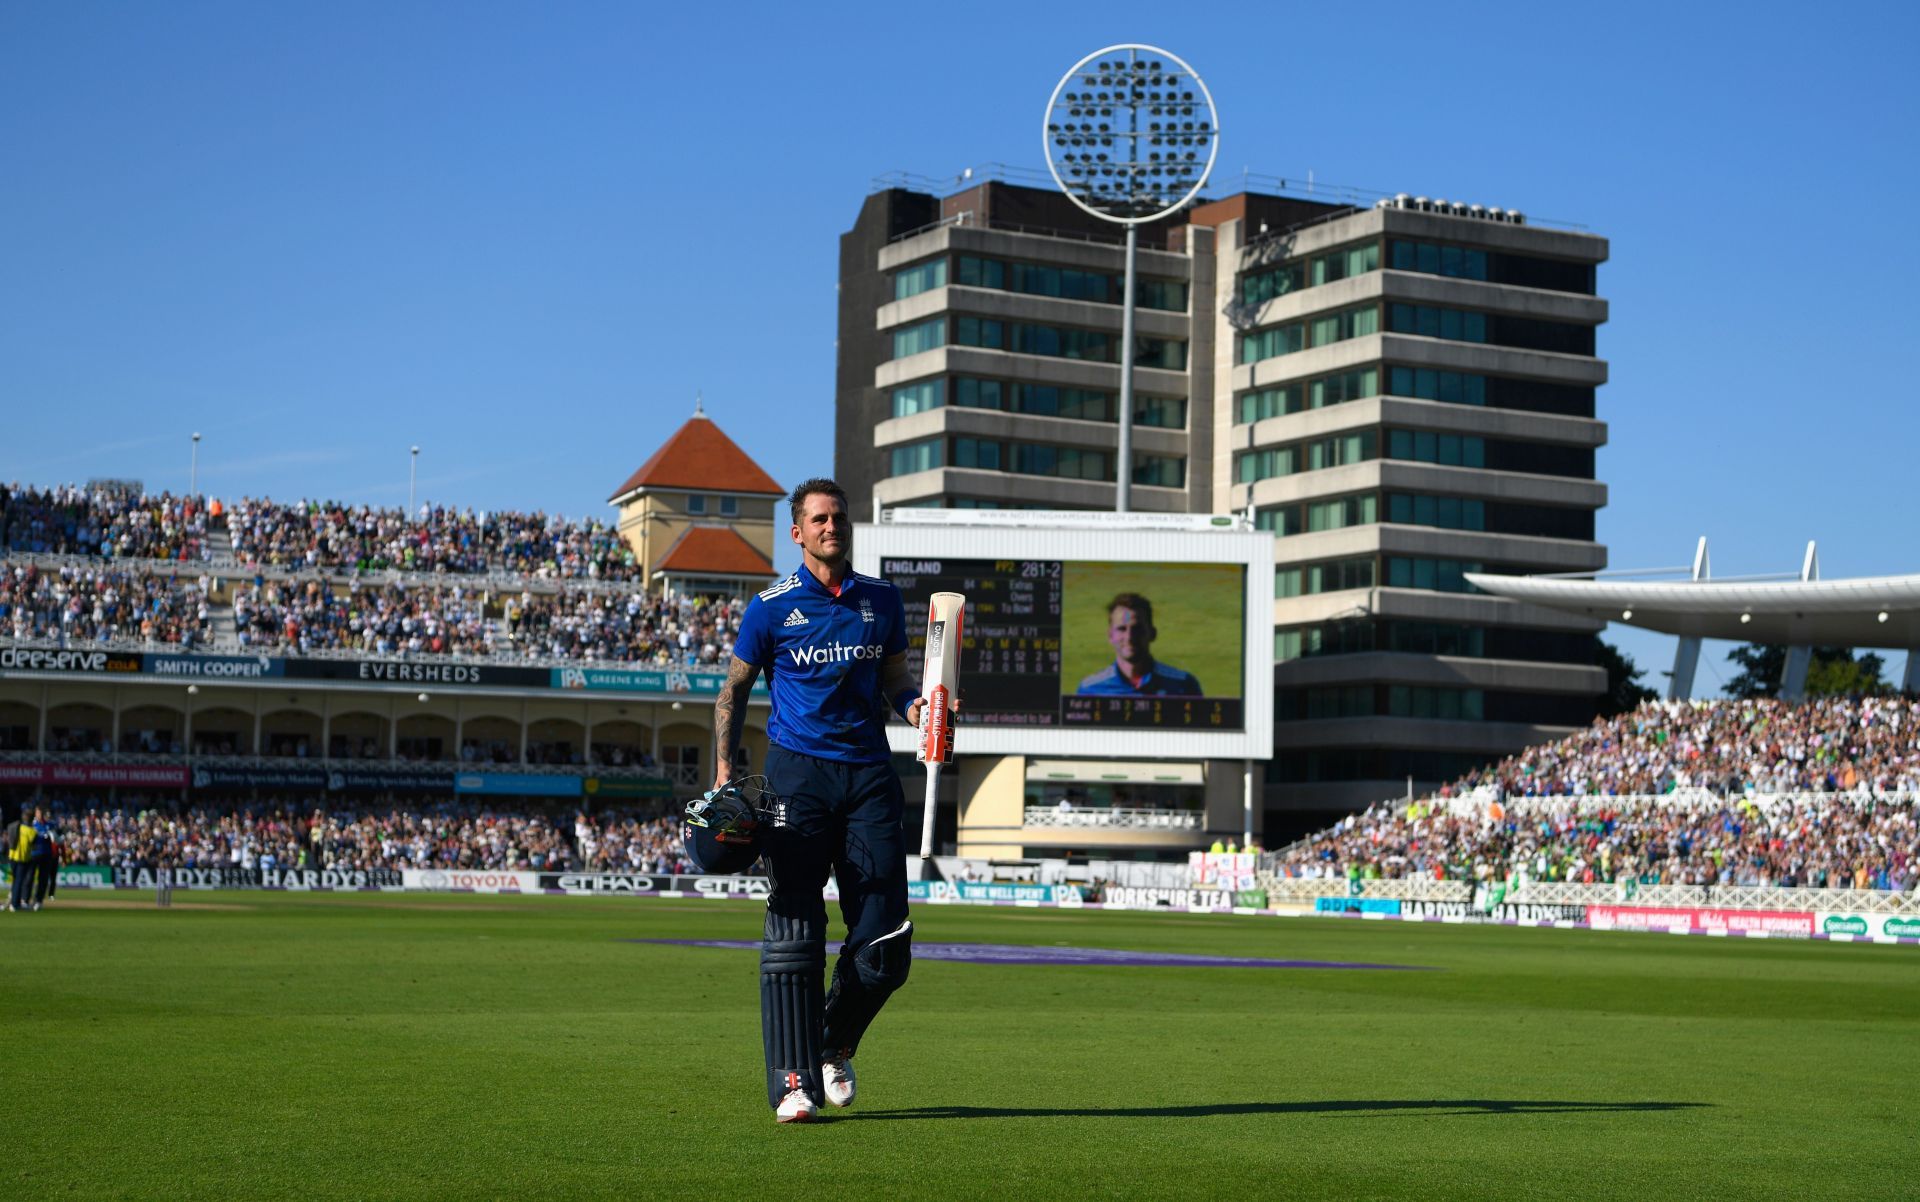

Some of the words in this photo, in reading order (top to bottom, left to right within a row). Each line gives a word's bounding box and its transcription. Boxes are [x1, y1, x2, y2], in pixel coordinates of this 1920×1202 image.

[885, 561, 941, 575] ENGLAND
[1021, 562, 1061, 578] 281-2
[1009, 580, 1034, 590] Extras
[1010, 591, 1034, 601] Overs
[784, 618, 809, 627] adidas
[789, 641, 883, 667] Waitrose
[155, 660, 200, 674] SMITH
[203, 661, 261, 676] COOPER
[360, 662, 480, 682] EVERSHEDS
[561, 669, 588, 689] IPA
[590, 674, 631, 685] GREENE
[634, 676, 661, 686] KING
[665, 673, 692, 692] IPA
[90, 768, 127, 781] HEALTH
[129, 769, 184, 783] INSURANCE
[261, 868, 366, 888] HARDYS
[450, 875, 520, 887] TOYOTA
[558, 876, 653, 890] ETIHAD
[694, 879, 770, 892] ETIHA
[929, 880, 961, 900] IPA
[964, 886, 987, 899] TIME
[1051, 884, 1082, 903] IPA
[1105, 887, 1197, 908] YORKSHIRE
[1200, 890, 1231, 909] TEA
[1401, 901, 1466, 917] HARDYS
[1491, 902, 1562, 922] HARDYS
